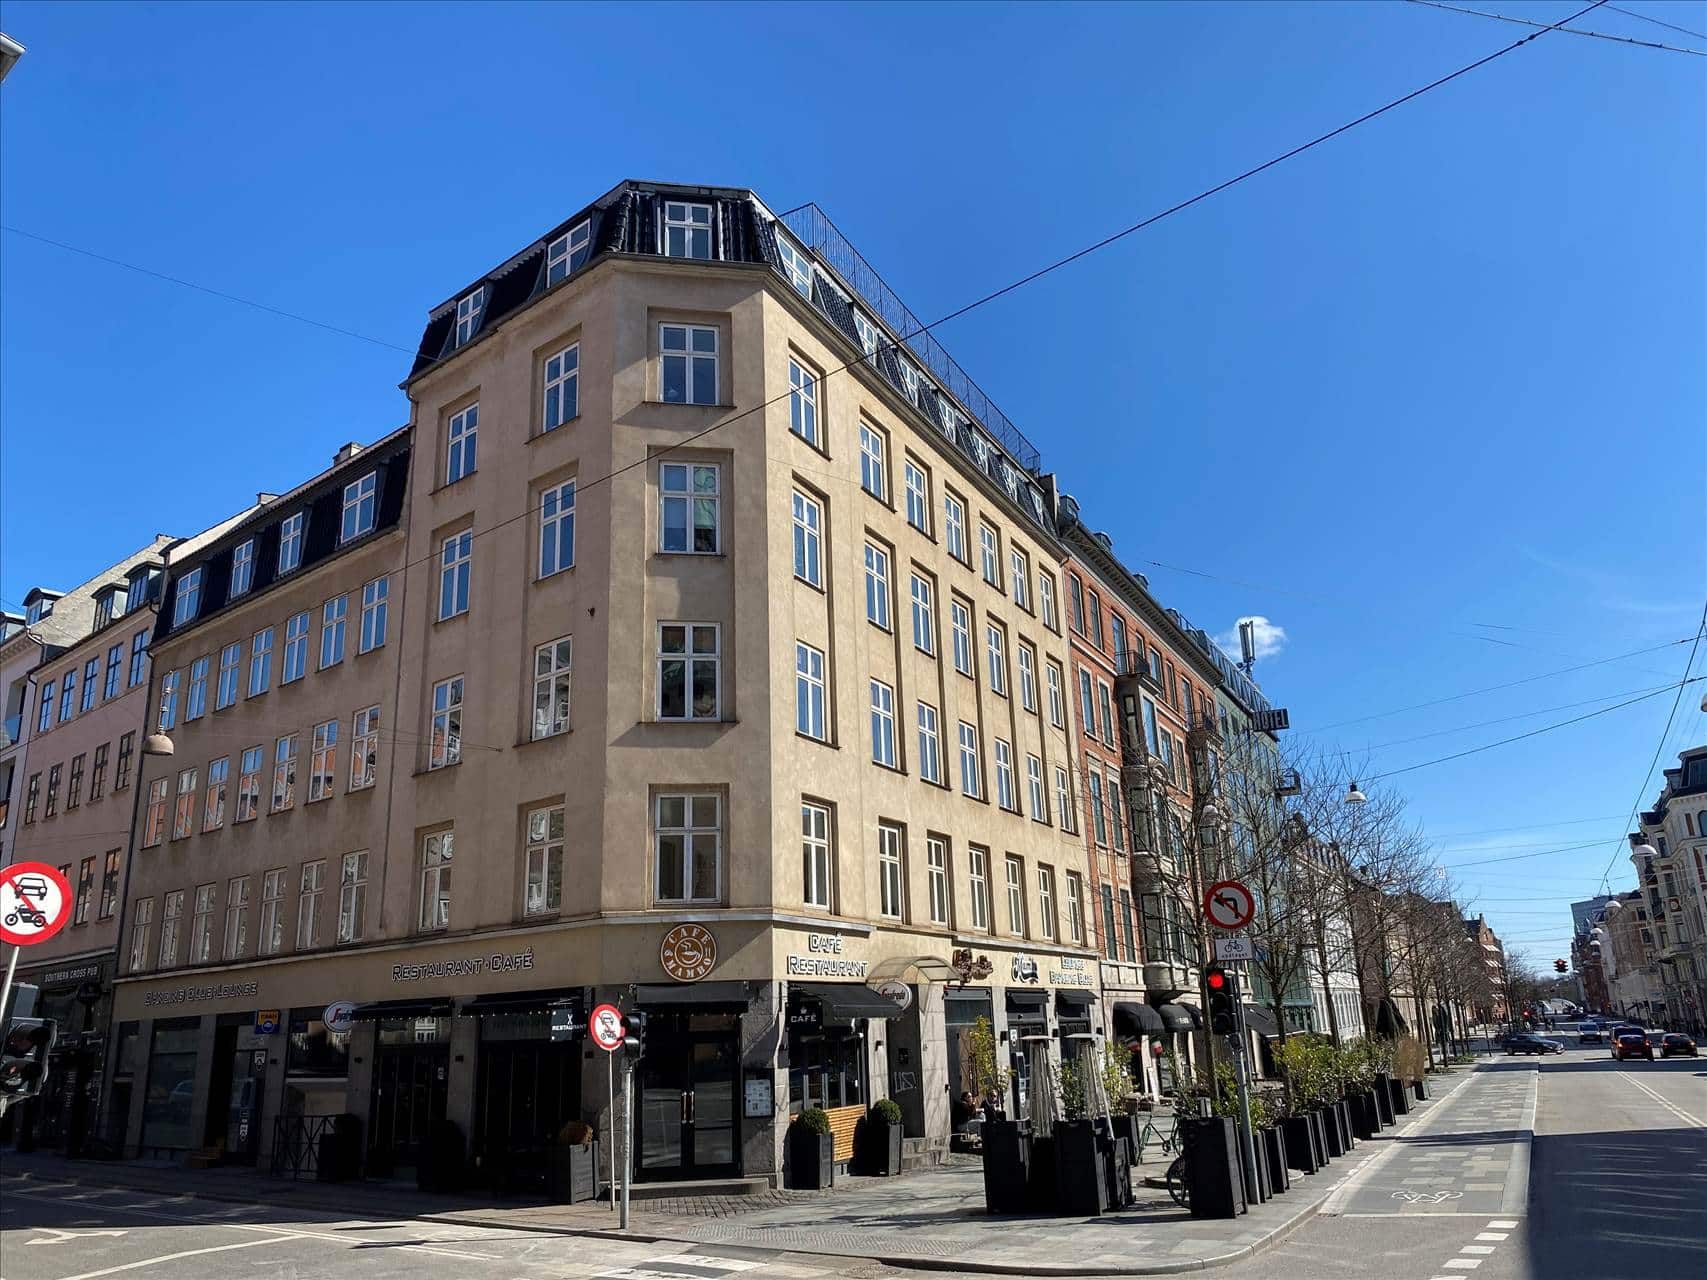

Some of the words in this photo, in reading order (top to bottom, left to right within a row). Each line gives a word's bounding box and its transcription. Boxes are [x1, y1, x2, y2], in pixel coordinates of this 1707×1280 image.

[1253, 709, 1288, 731] HOTEL
[809, 932, 842, 954] CAFÉ
[392, 958, 484, 981] RESTAURANT
[787, 954, 868, 977] RESTAURANT
